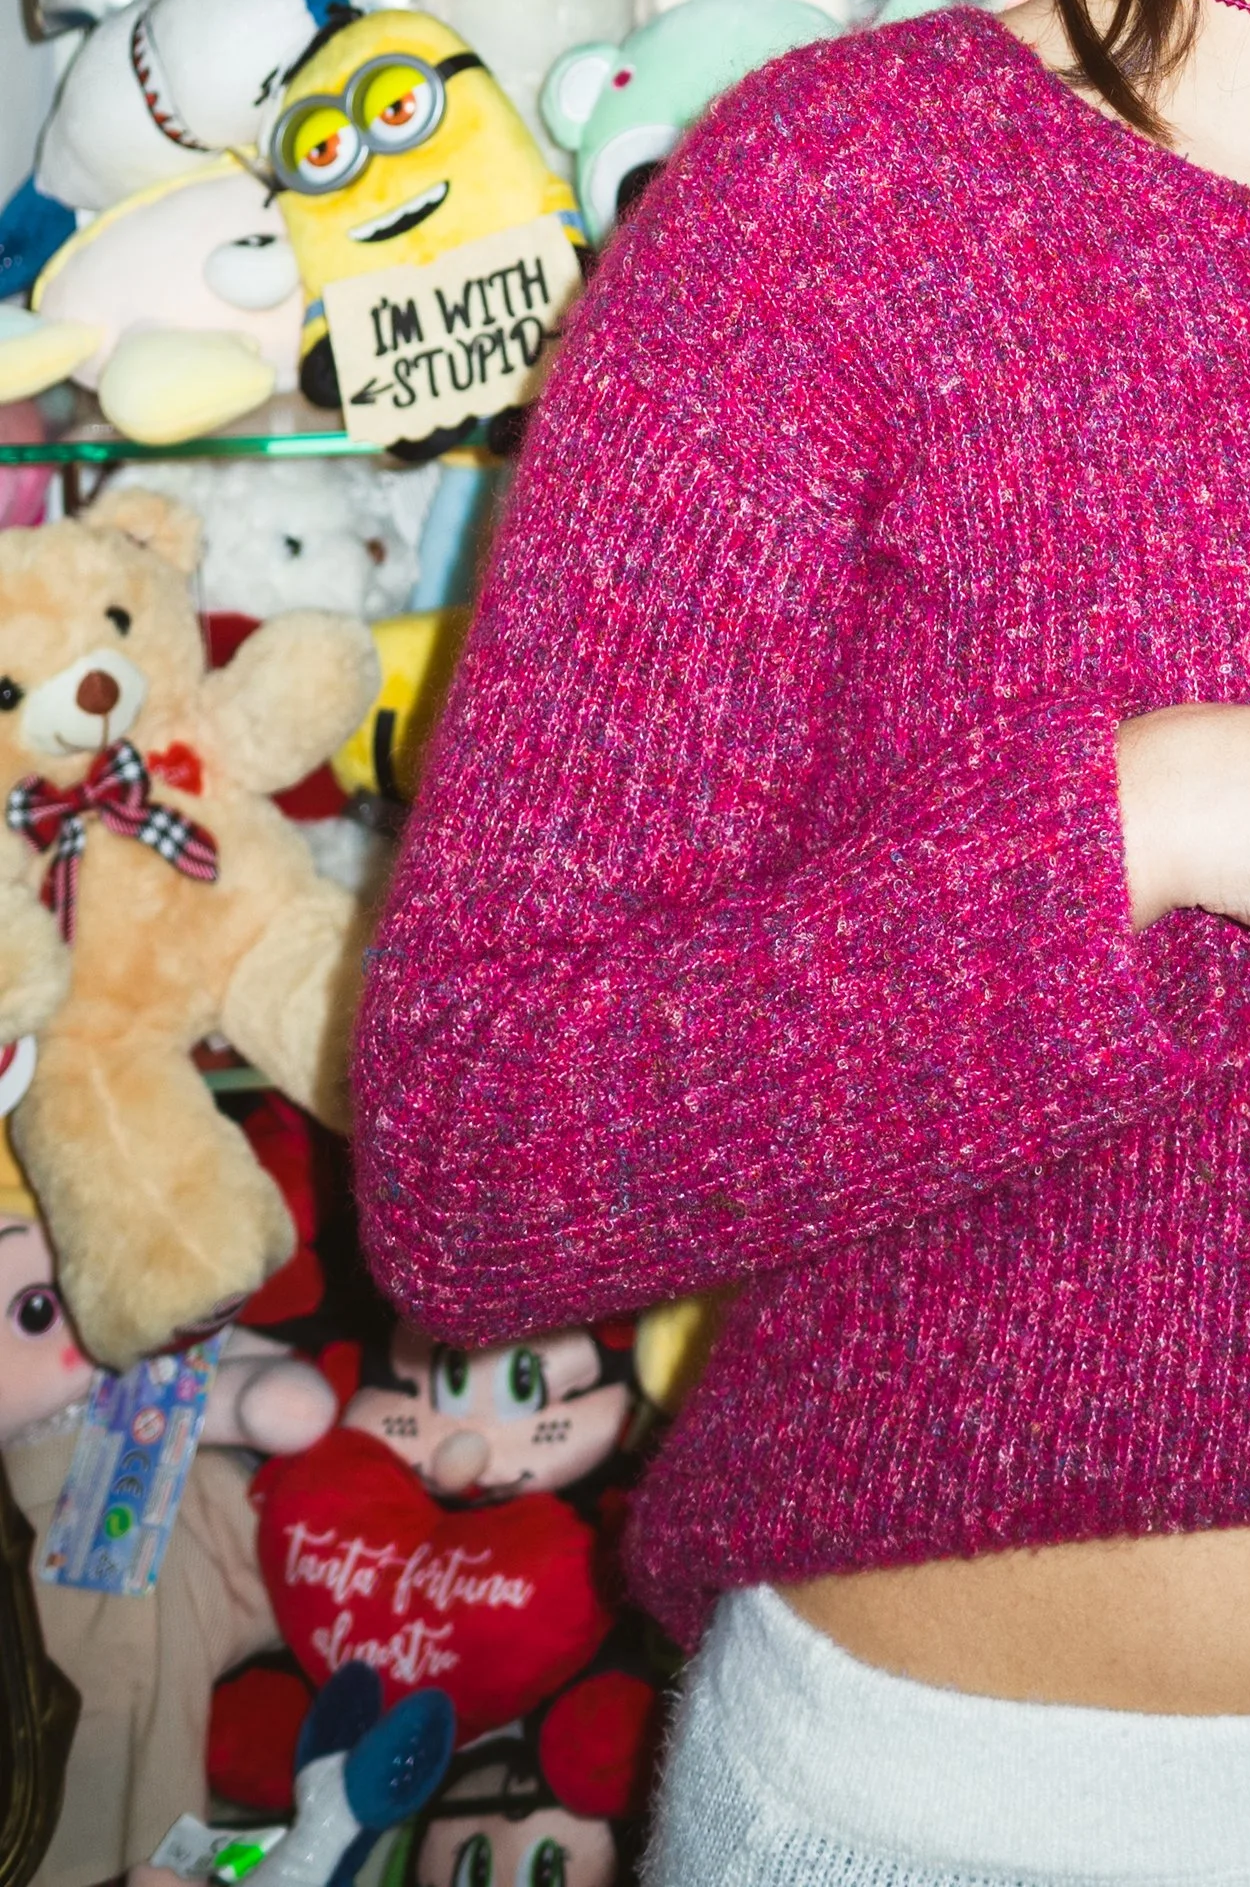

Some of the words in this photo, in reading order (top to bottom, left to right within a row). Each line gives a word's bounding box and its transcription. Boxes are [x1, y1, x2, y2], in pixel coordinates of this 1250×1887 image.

[371, 297, 424, 356] I'M
[434, 257, 549, 334] WITH
[393, 316, 543, 408] STUPID
[392, 1542, 535, 1616] fortuna
